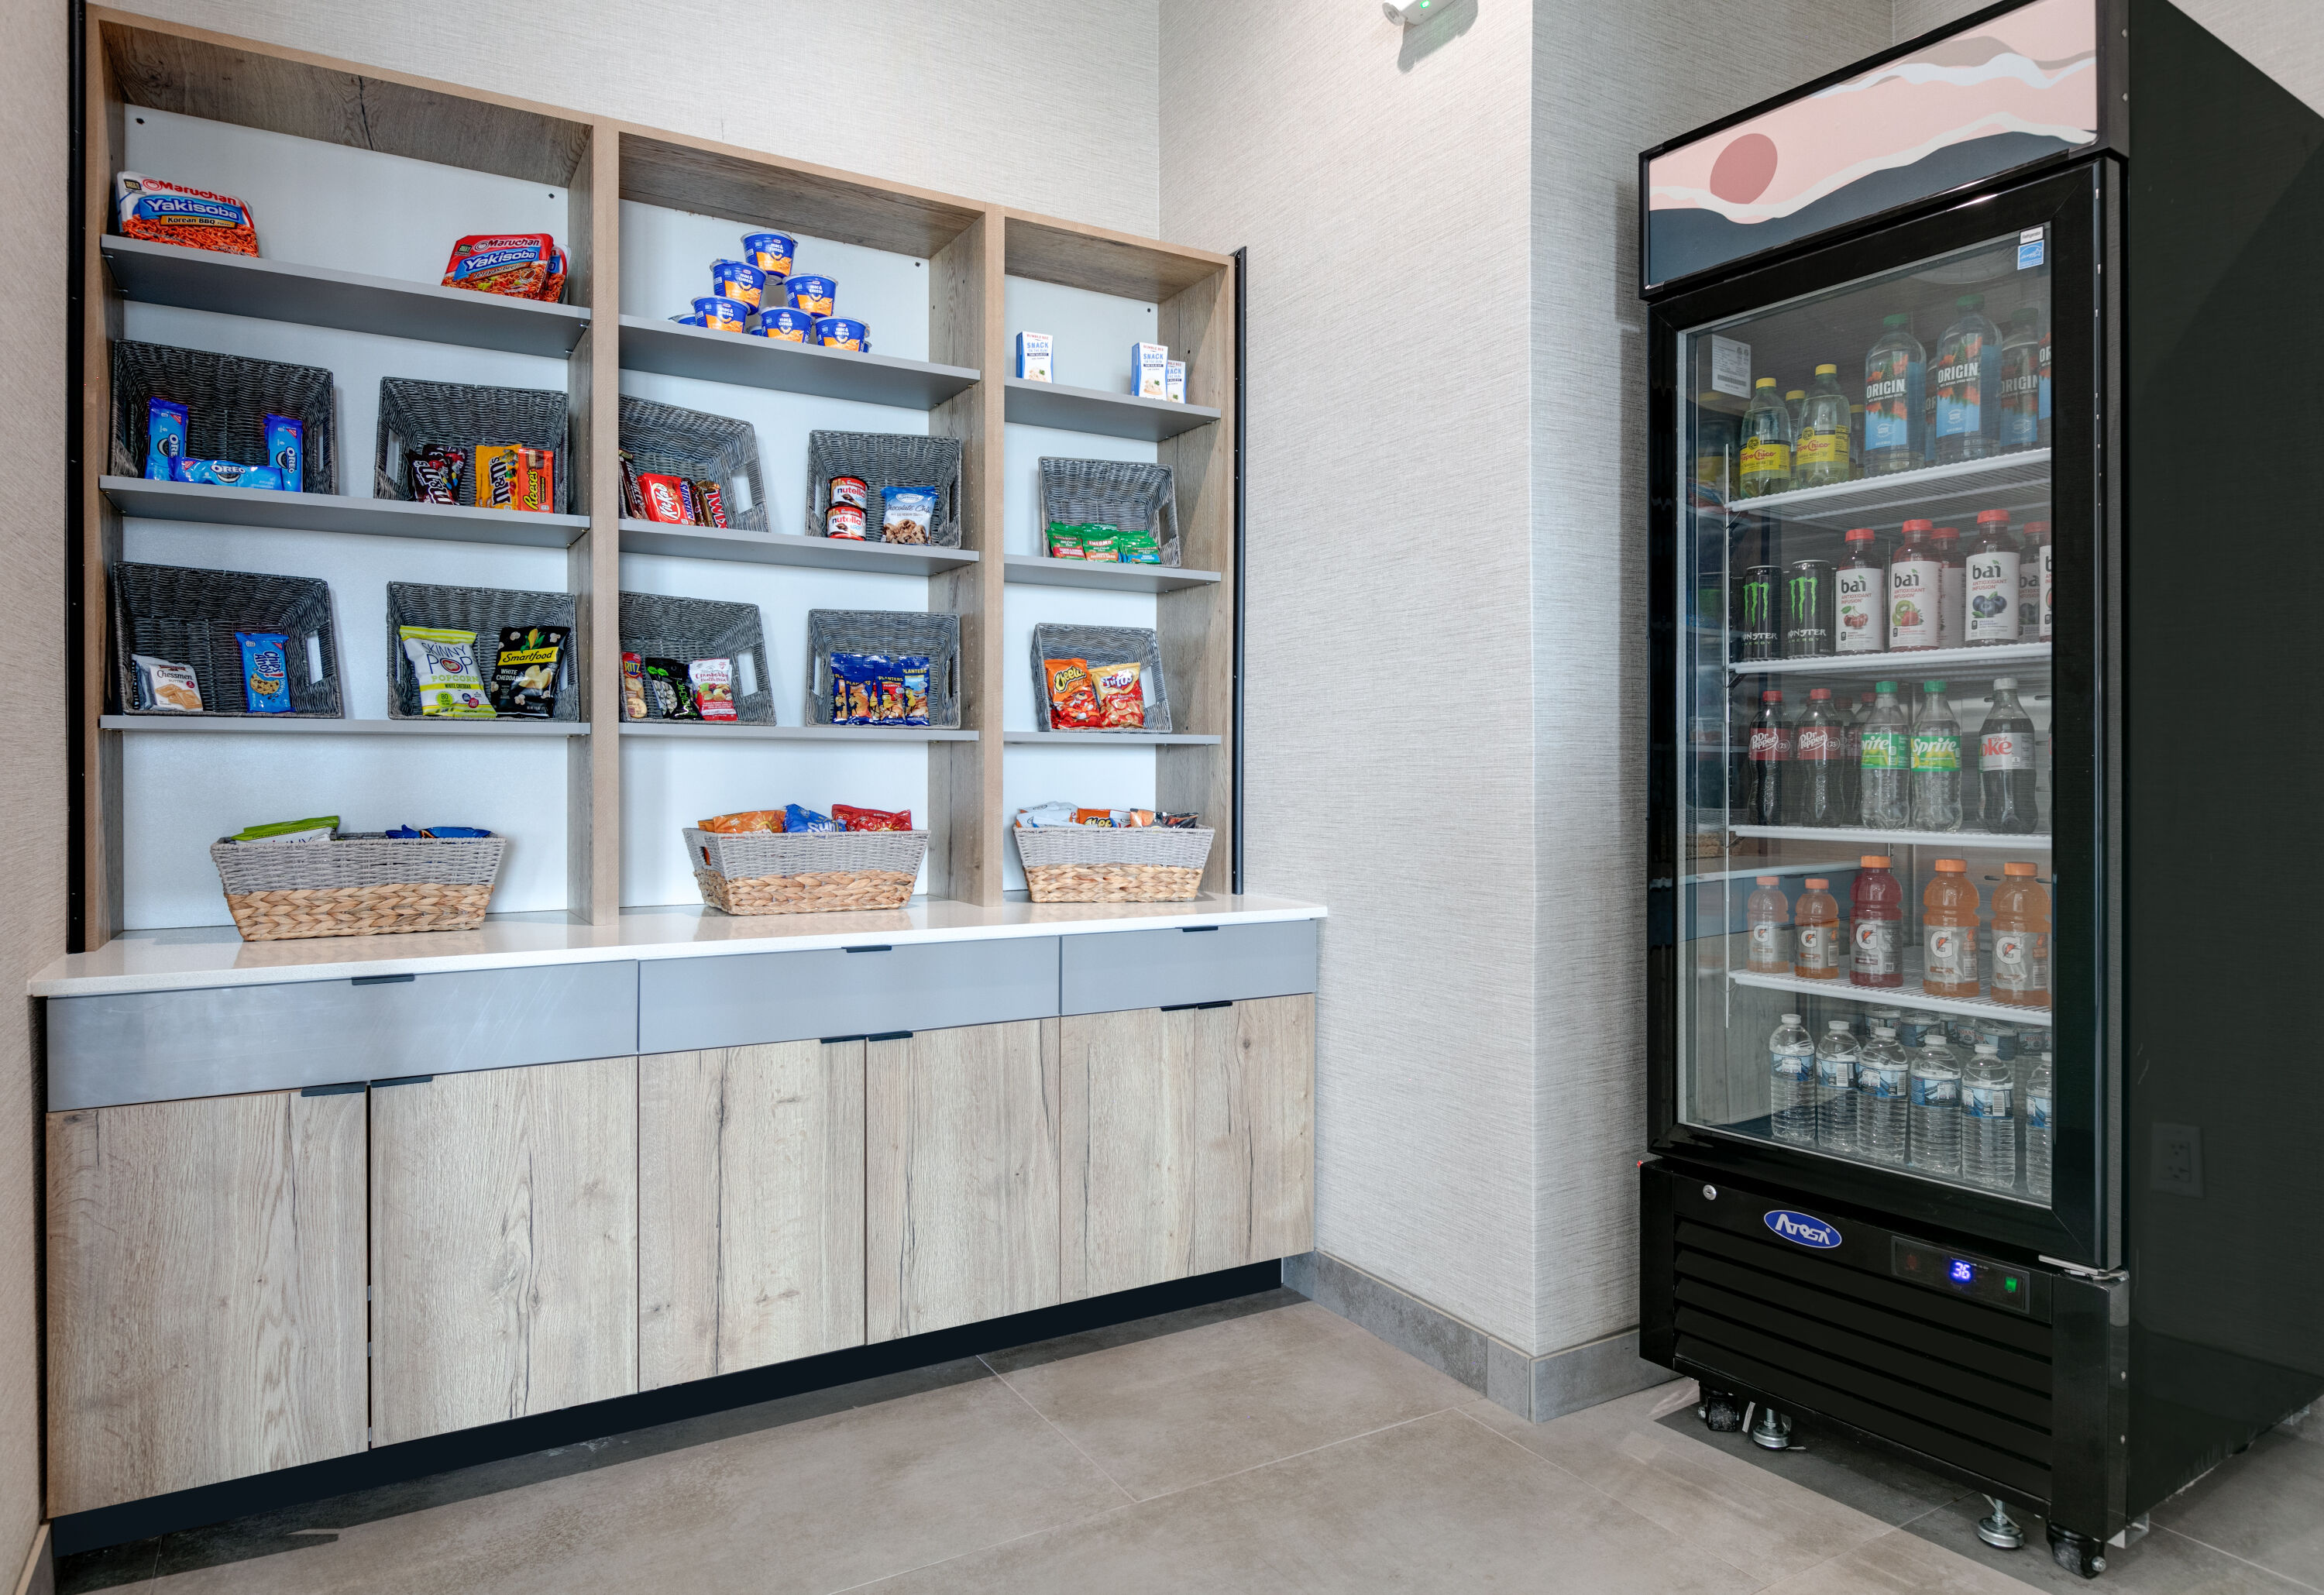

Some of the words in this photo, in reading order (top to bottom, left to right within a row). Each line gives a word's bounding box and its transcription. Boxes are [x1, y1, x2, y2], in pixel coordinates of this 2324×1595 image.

[160, 180, 237, 206] Maruchan
[146, 198, 239, 220] Yakisoba
[488, 239, 540, 247] Maruchan
[466, 251, 535, 270] Yakisoba
[473, 267, 503, 279] Teriyaki
[1938, 362, 1978, 383] ORIGIN
[1866, 378, 1906, 399] ORIGIN
[168, 434, 180, 457] ORE
[1754, 449, 1777, 460] Chico
[1808, 439, 1831, 452] Chico
[210, 465, 246, 473] OREO
[286, 447, 295, 473] OREO
[523, 469, 539, 510] Reese's
[837, 488, 865, 498] nutella
[705, 490, 727, 528] TWIX
[832, 517, 861, 525] nutella
[1894, 569, 1920, 588] bai
[1972, 561, 2001, 579] bai
[1841, 576, 1867, 593] bai
[421, 641, 466, 657] SKINNY
[503, 650, 554, 664] Smartfood
[263, 651, 283, 674] Chips
[427, 654, 473, 675] POP
[624, 662, 641, 673] RITZ
[156, 670, 193, 681] Chessmen
[1101, 670, 1133, 688] Fritos
[1751, 734, 1777, 749] Pepper
[1758, 732, 1769, 742] Dr
[1800, 734, 1827, 749] Pepper
[1807, 732, 1817, 741] Dr
[1913, 737, 1956, 756] Sprite
[1981, 738, 2013, 757] oke
[1754, 924, 1769, 942] G
[1801, 930, 1817, 948] G
[1856, 924, 1878, 950] G
[1930, 930, 1953, 958] G
[1996, 936, 2022, 964] G
[1952, 1262, 1971, 1279] 36
